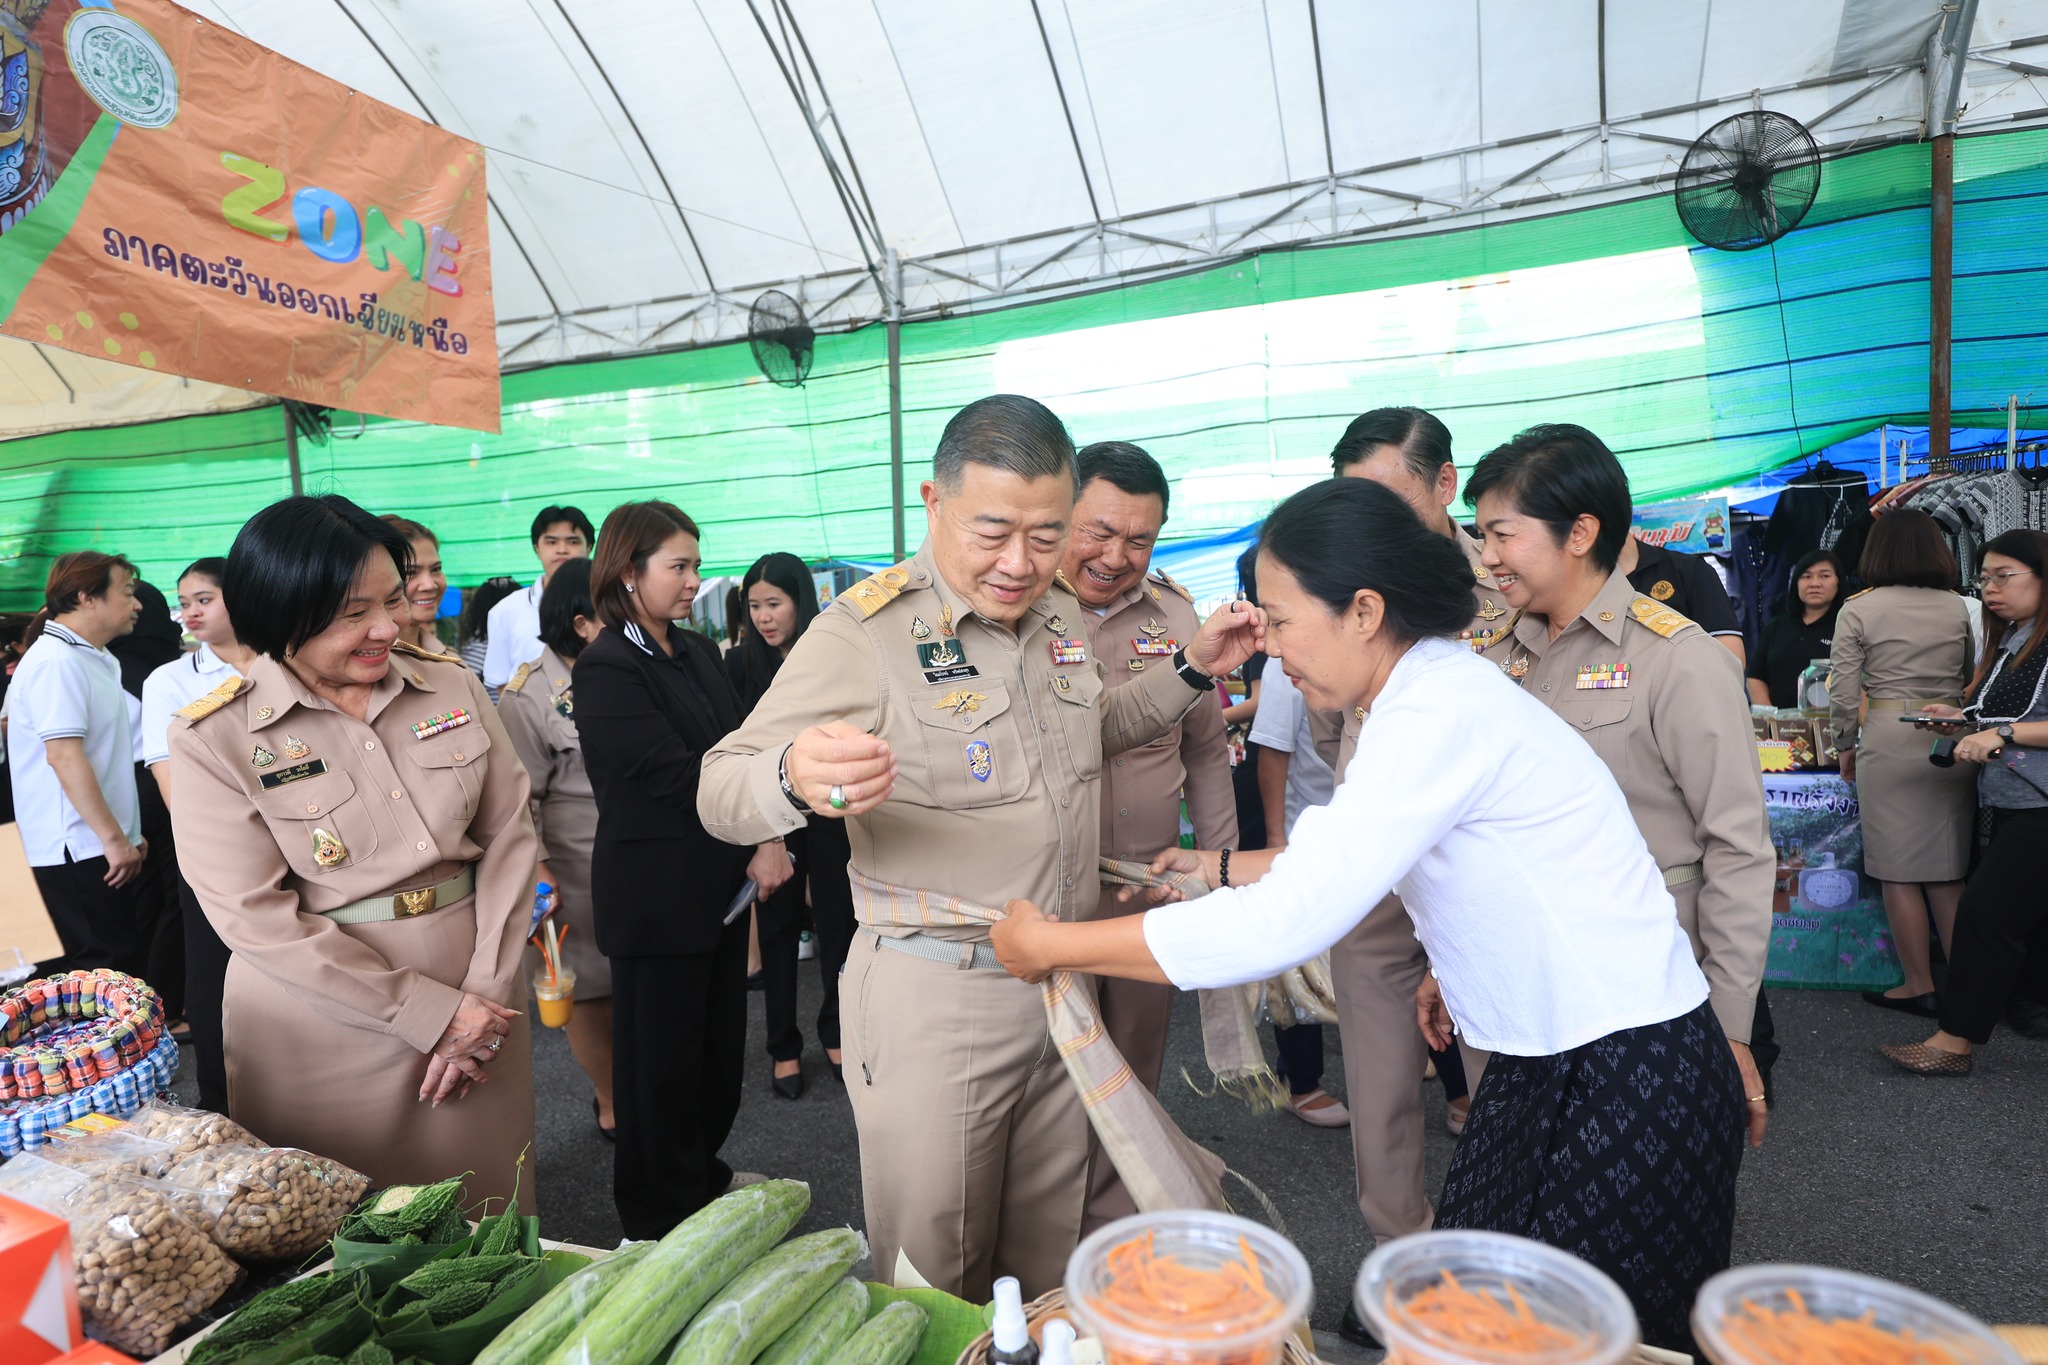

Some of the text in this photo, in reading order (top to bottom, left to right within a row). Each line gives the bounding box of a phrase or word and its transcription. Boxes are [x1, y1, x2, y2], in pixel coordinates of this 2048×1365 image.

[102, 226, 468, 354] ภาคตะวันออกเฉียงเหนือ
[219, 151, 463, 298] ZONE
